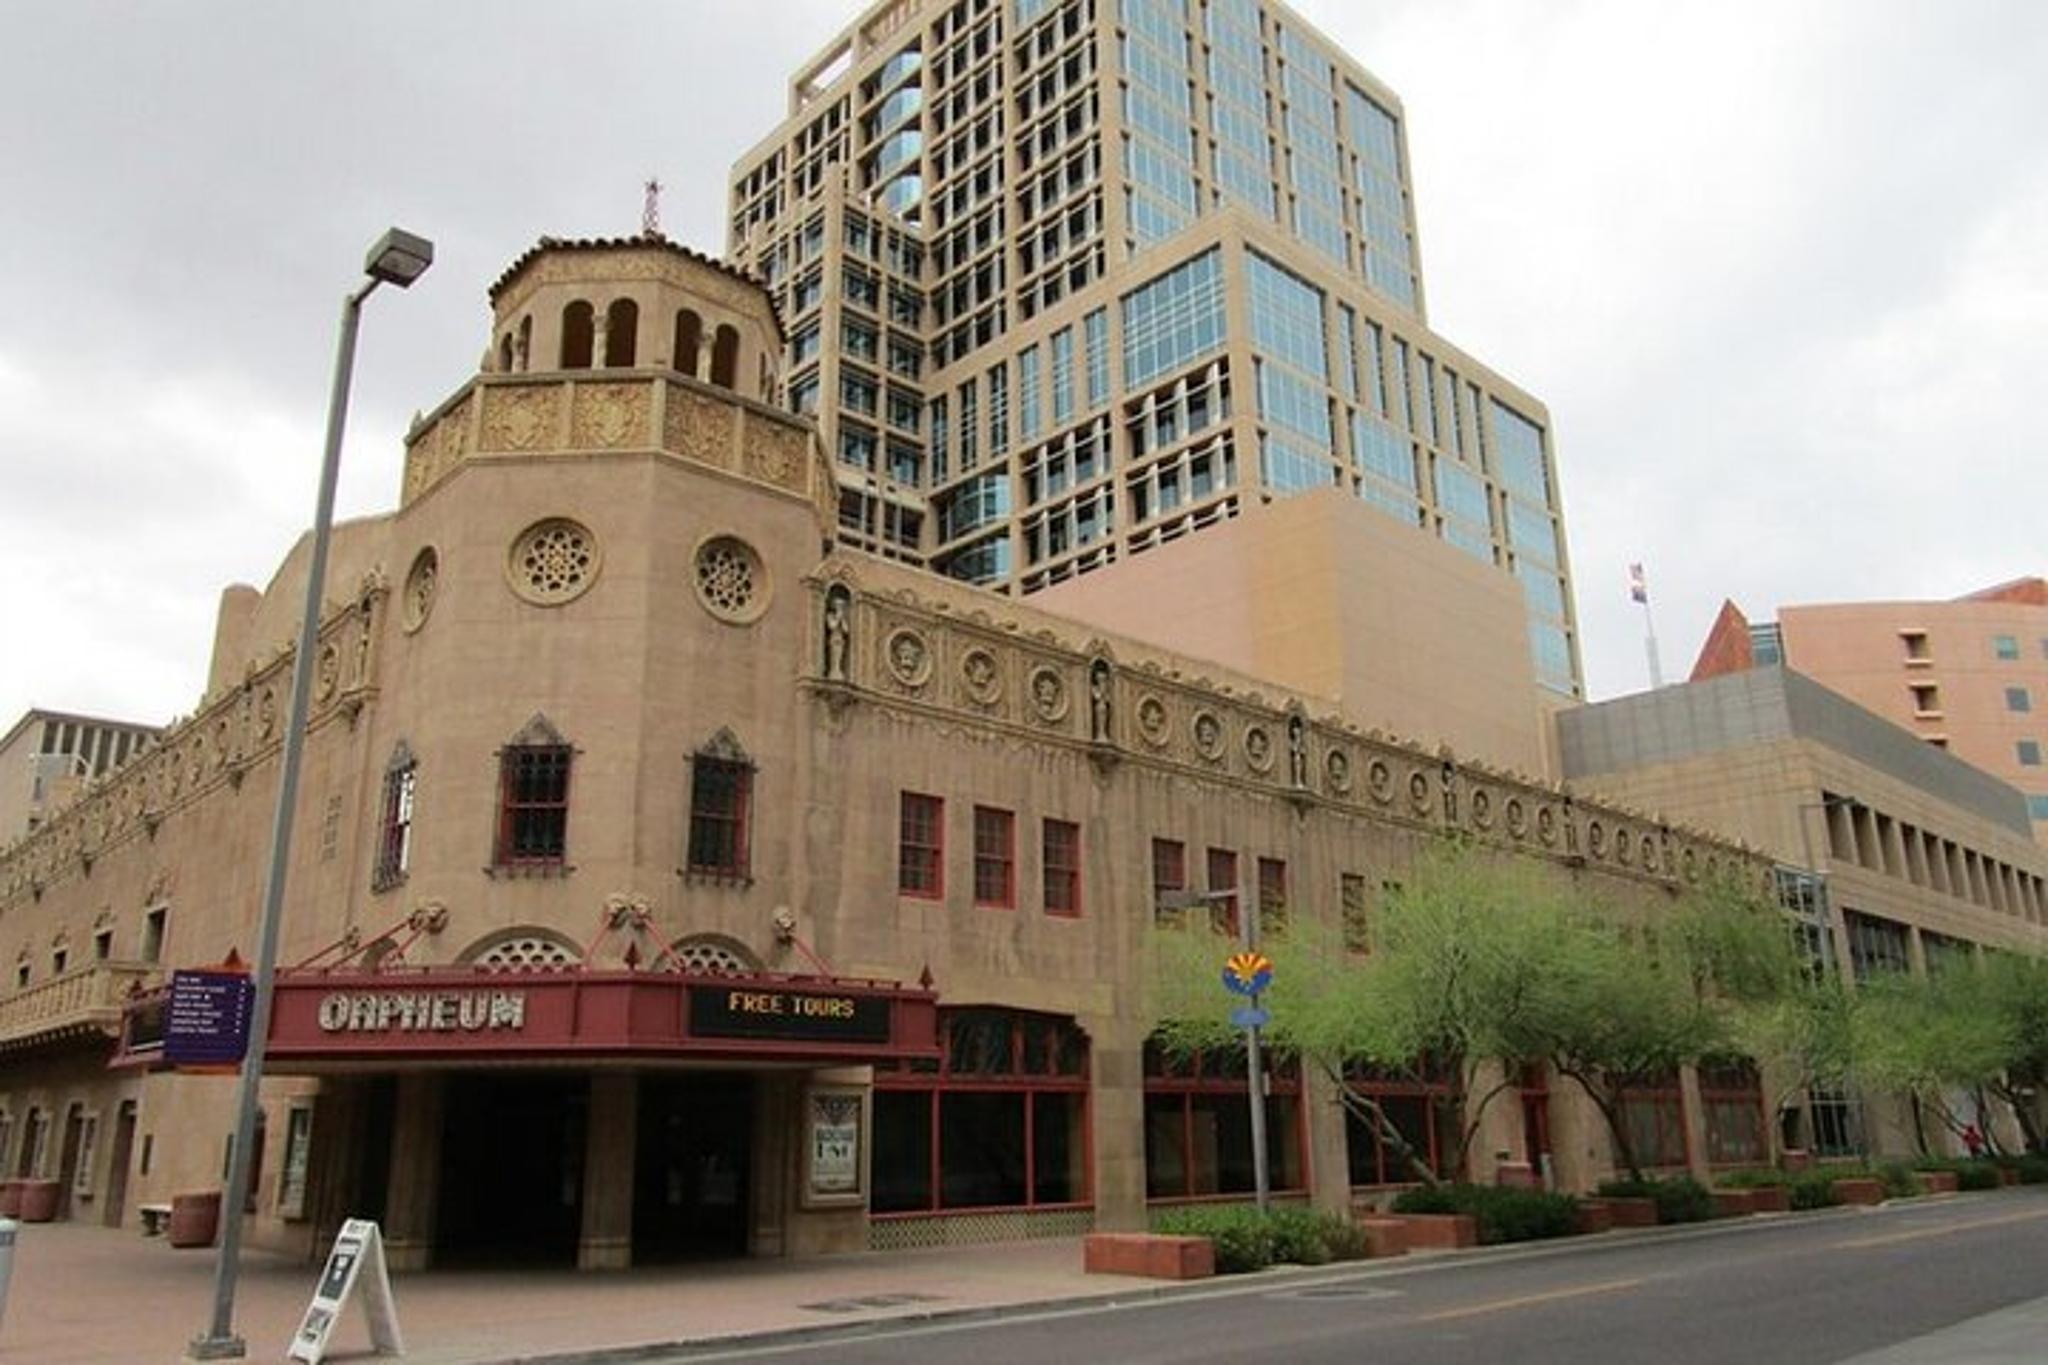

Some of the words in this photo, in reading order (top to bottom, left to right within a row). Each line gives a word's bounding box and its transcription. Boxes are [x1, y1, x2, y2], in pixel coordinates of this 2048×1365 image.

[319, 991, 525, 1031] ORPHEUM
[728, 991, 784, 1014] FREE
[793, 997, 855, 1017] TOURS
